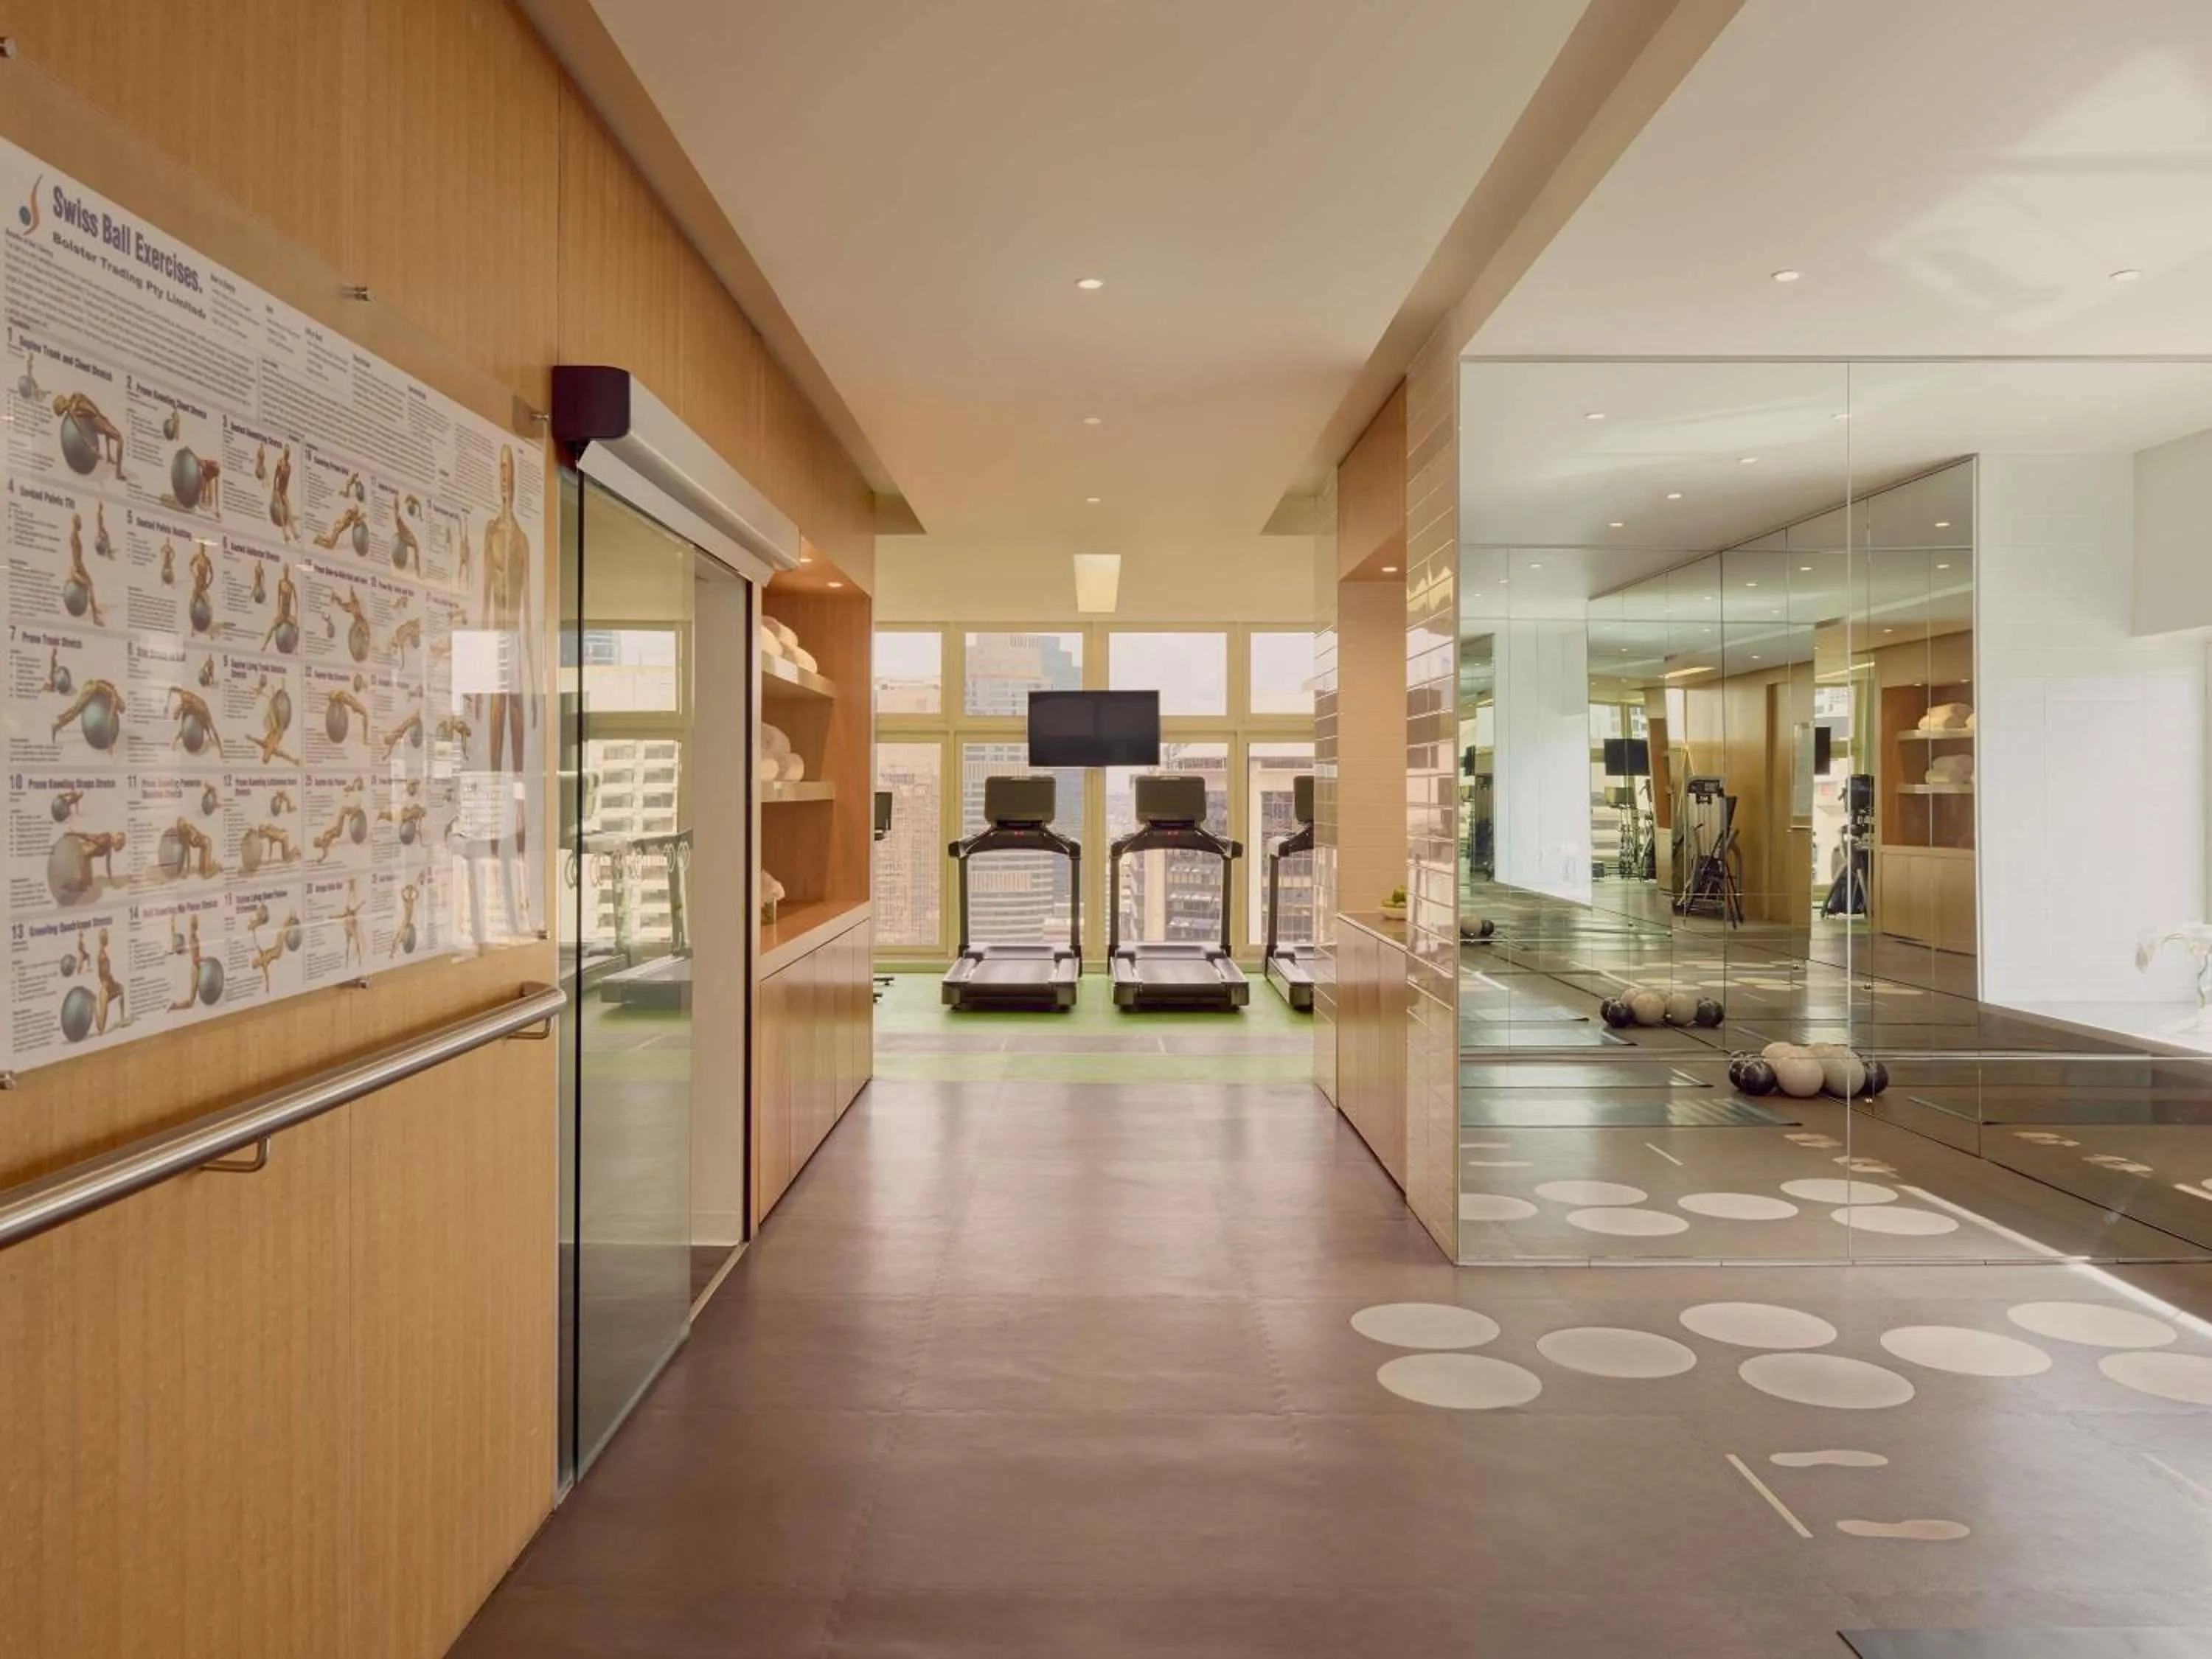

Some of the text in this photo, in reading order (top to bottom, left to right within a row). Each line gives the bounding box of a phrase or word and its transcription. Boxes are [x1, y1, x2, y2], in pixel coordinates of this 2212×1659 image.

[53, 186, 98, 238] Swiss
[102, 213, 131, 255] Ball
[53, 232, 97, 262] Bolster
[100, 257, 143, 290] Trading
[146, 280, 164, 299] Pty
[7, 478, 14, 493] 4
[9, 626, 16, 641] 7
[9, 773, 23, 790] 10
[128, 775, 136, 788] 11
[129, 905, 139, 920] 14
[12, 923, 24, 939] 13
